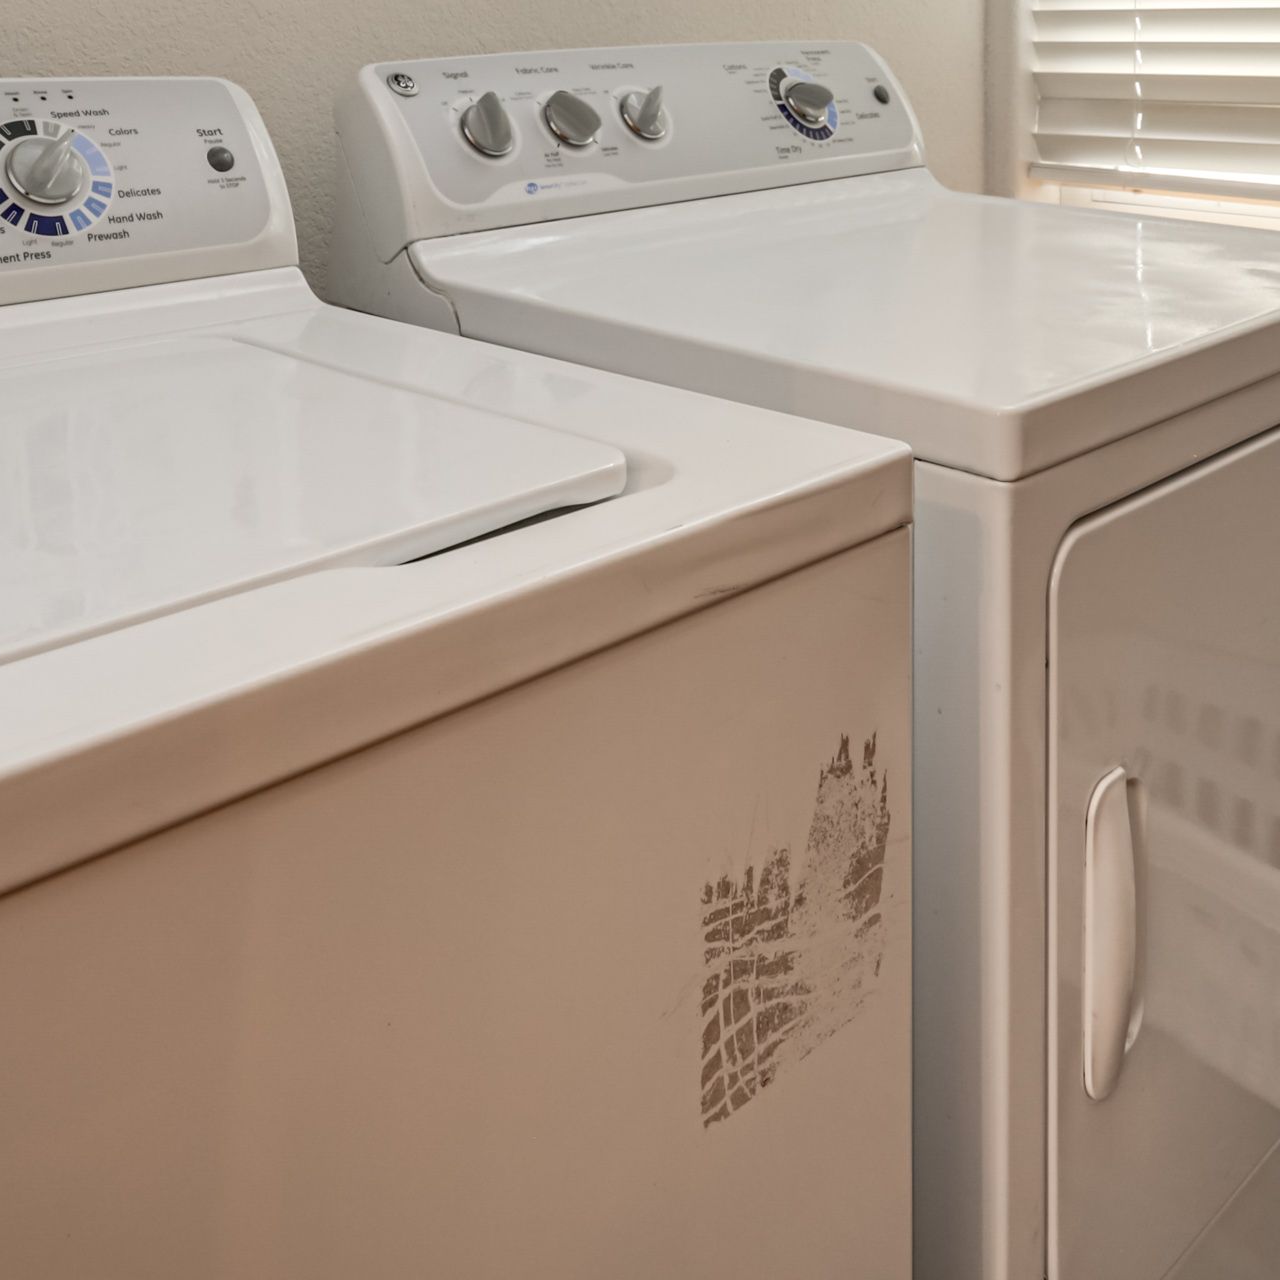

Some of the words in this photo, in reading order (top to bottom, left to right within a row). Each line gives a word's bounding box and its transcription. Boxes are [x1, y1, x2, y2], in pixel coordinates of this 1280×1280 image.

[50, 110, 81, 119] Speed
[82, 108, 110, 117] Wash
[109, 128, 139, 136] Colors
[196, 128, 224, 137] Start
[117, 187, 162, 199] Delicates
[107, 213, 135, 224] Hand
[136, 210, 164, 221] Wash
[87, 229, 130, 242] Prewash
[23, 250, 52, 261] Press
